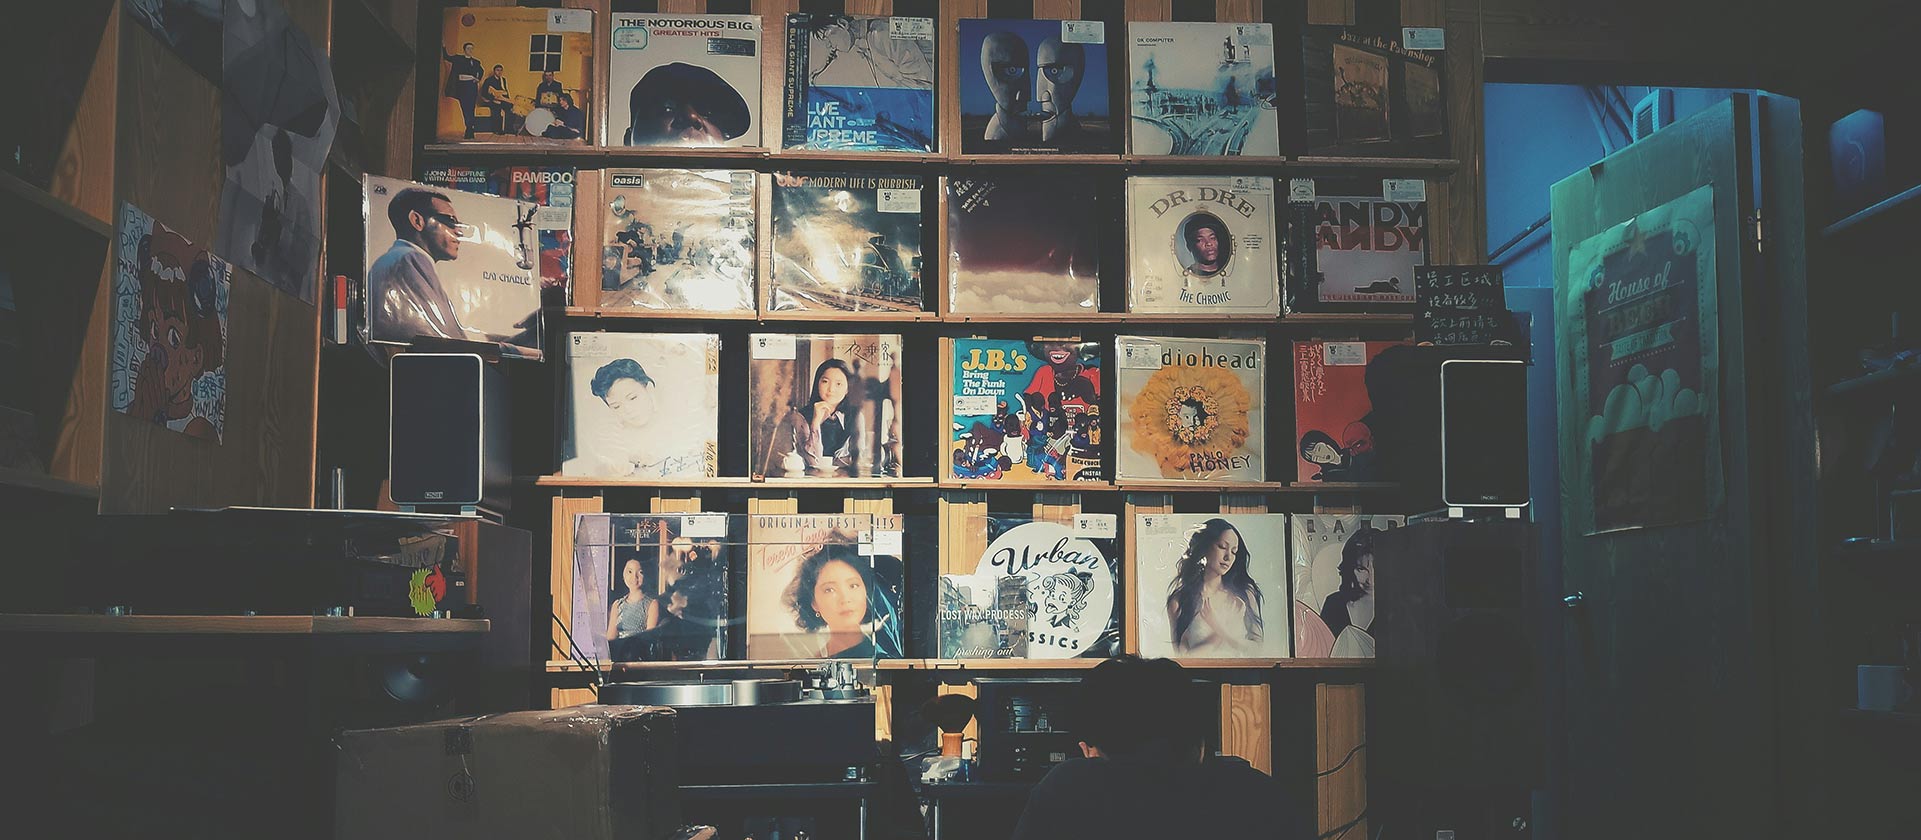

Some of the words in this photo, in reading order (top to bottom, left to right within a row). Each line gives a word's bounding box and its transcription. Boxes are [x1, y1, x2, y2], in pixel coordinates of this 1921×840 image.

[619, 19, 645, 28] THE
[648, 19, 724, 29] NOTORIOUS
[1362, 36, 1370, 45] at
[1373, 36, 1387, 49] the
[808, 101, 840, 115] LUE
[807, 116, 846, 128] IANT
[807, 129, 877, 144] UPREME
[512, 171, 573, 184] BAMBOO
[614, 176, 641, 185] oasis
[809, 176, 847, 188] MODERN
[849, 177, 865, 188] LIFE
[868, 178, 876, 188] IS
[879, 178, 917, 189] RUBBISH
[1148, 190, 1193, 219] DR.
[1198, 187, 1255, 219] DRE
[1315, 201, 1423, 228] ANDY
[1316, 226, 1422, 251] ANDY
[499, 273, 532, 286] CHARLE
[1608, 279, 1650, 304] House
[1653, 261, 1671, 290] of
[1179, 287, 1193, 304] THE
[1196, 291, 1231, 305] CHRONIC
[961, 348, 1028, 371] J.B.'s
[1161, 346, 1256, 369] diohead
[962, 370, 989, 380] Bring
[963, 379, 981, 388] The
[981, 379, 1006, 388] Funk
[962, 387, 976, 396] On
[977, 387, 1006, 396] Down
[1189, 451, 1223, 462] PABLO
[1189, 455, 1250, 473] HONEY
[760, 517, 816, 529] ORIGINAL
[828, 518, 856, 529] BEST
[991, 537, 1099, 575] Urban
[941, 609, 962, 621] LOST
[963, 609, 983, 621] WAX
[985, 609, 1025, 621] PROCESS
[1029, 632, 1078, 650] SSICS
[953, 646, 994, 659] pushing
[997, 647, 1014, 656] out
